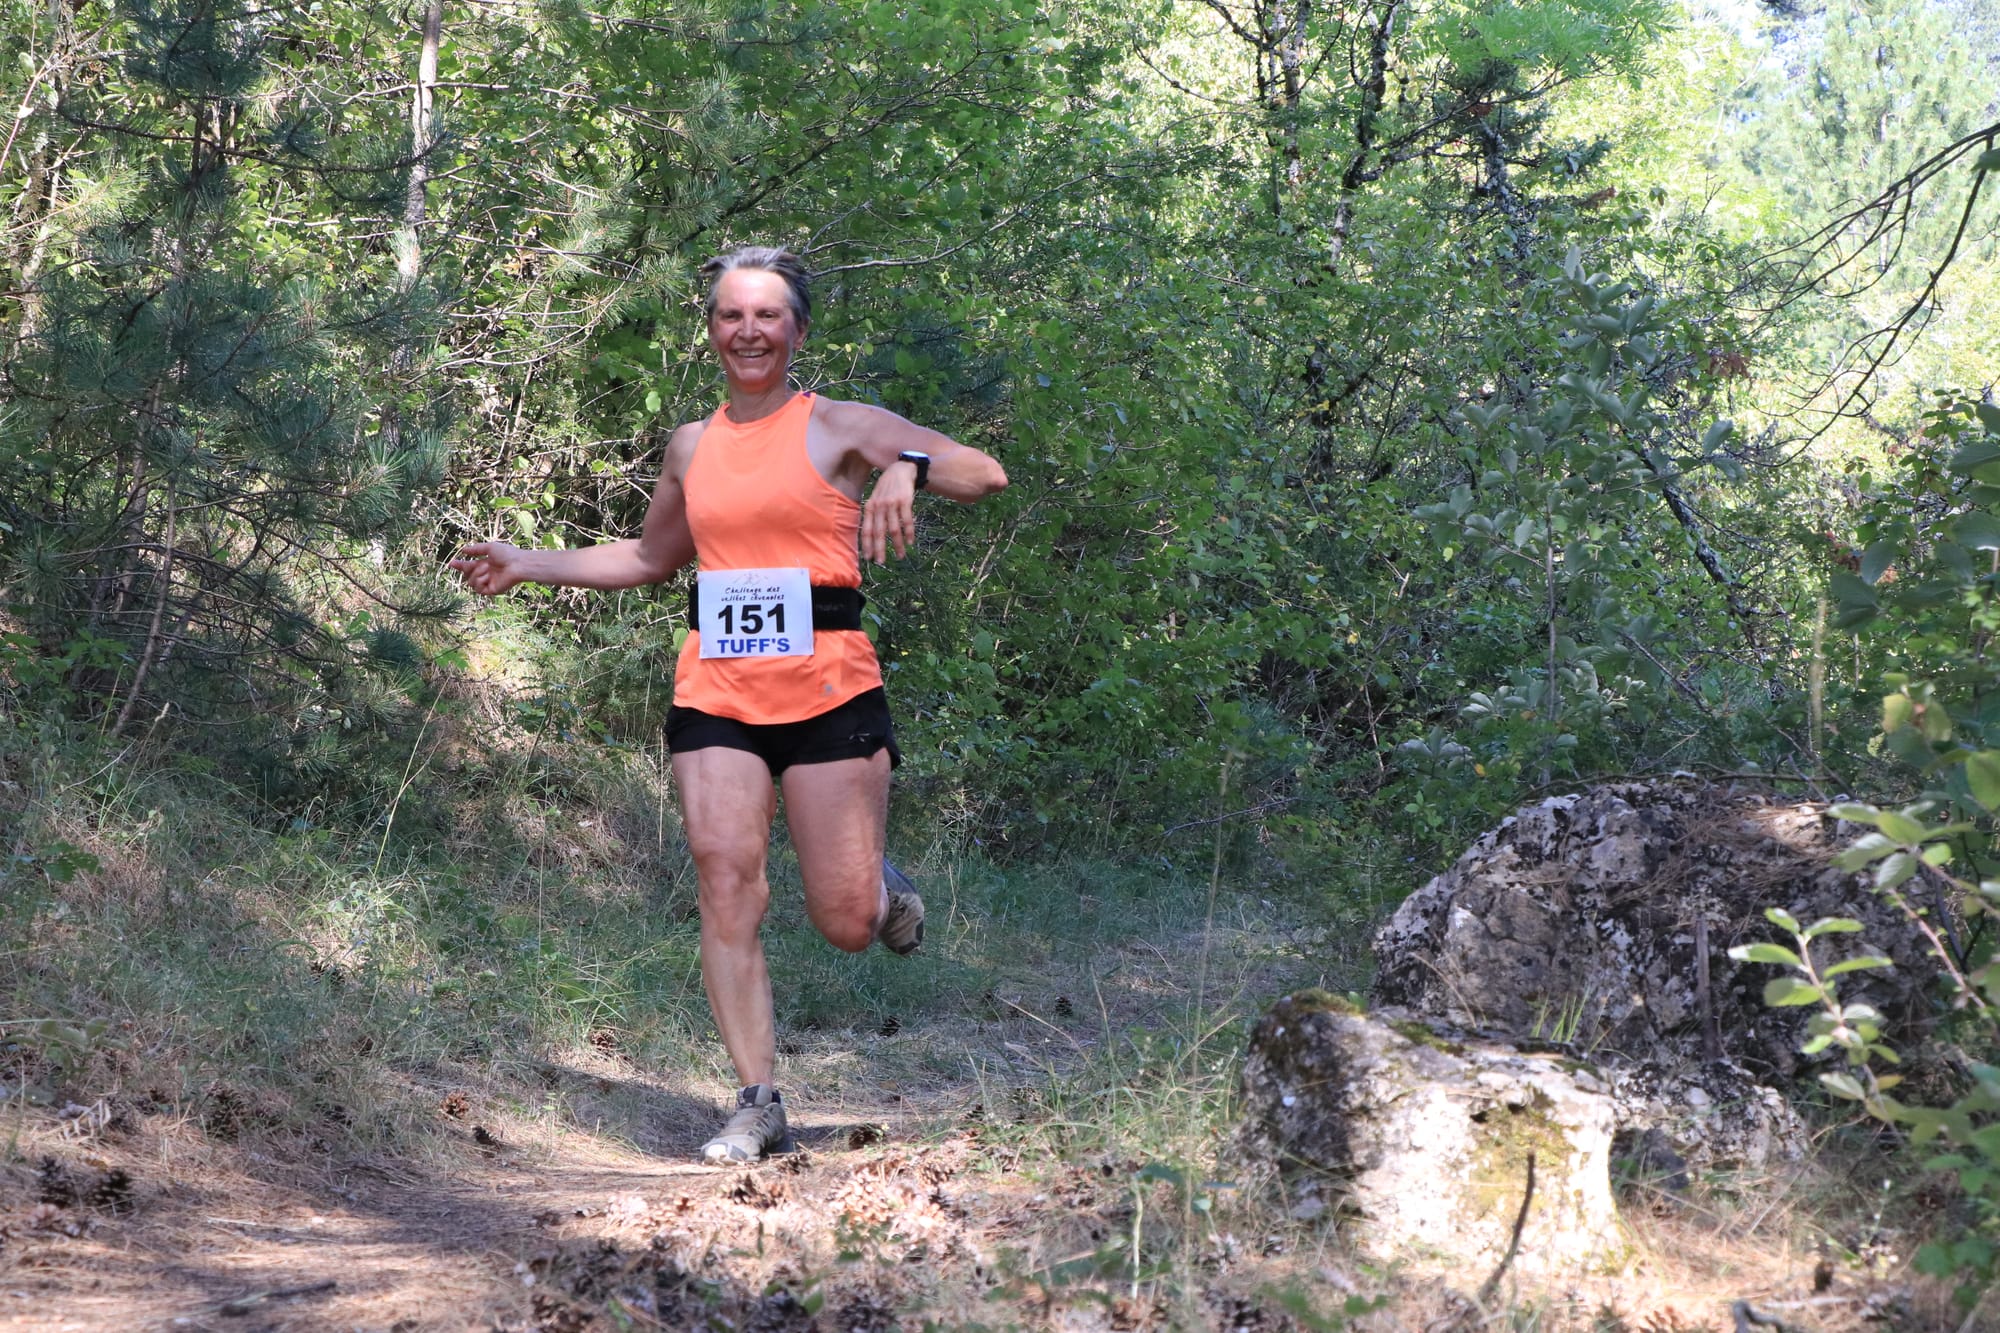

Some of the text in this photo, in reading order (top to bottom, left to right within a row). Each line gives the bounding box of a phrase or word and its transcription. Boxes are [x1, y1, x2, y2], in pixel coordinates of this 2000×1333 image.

[725, 587, 761, 595] Challenge
[718, 603, 785, 635] 151
[716, 638, 790, 654] TUFF'S
